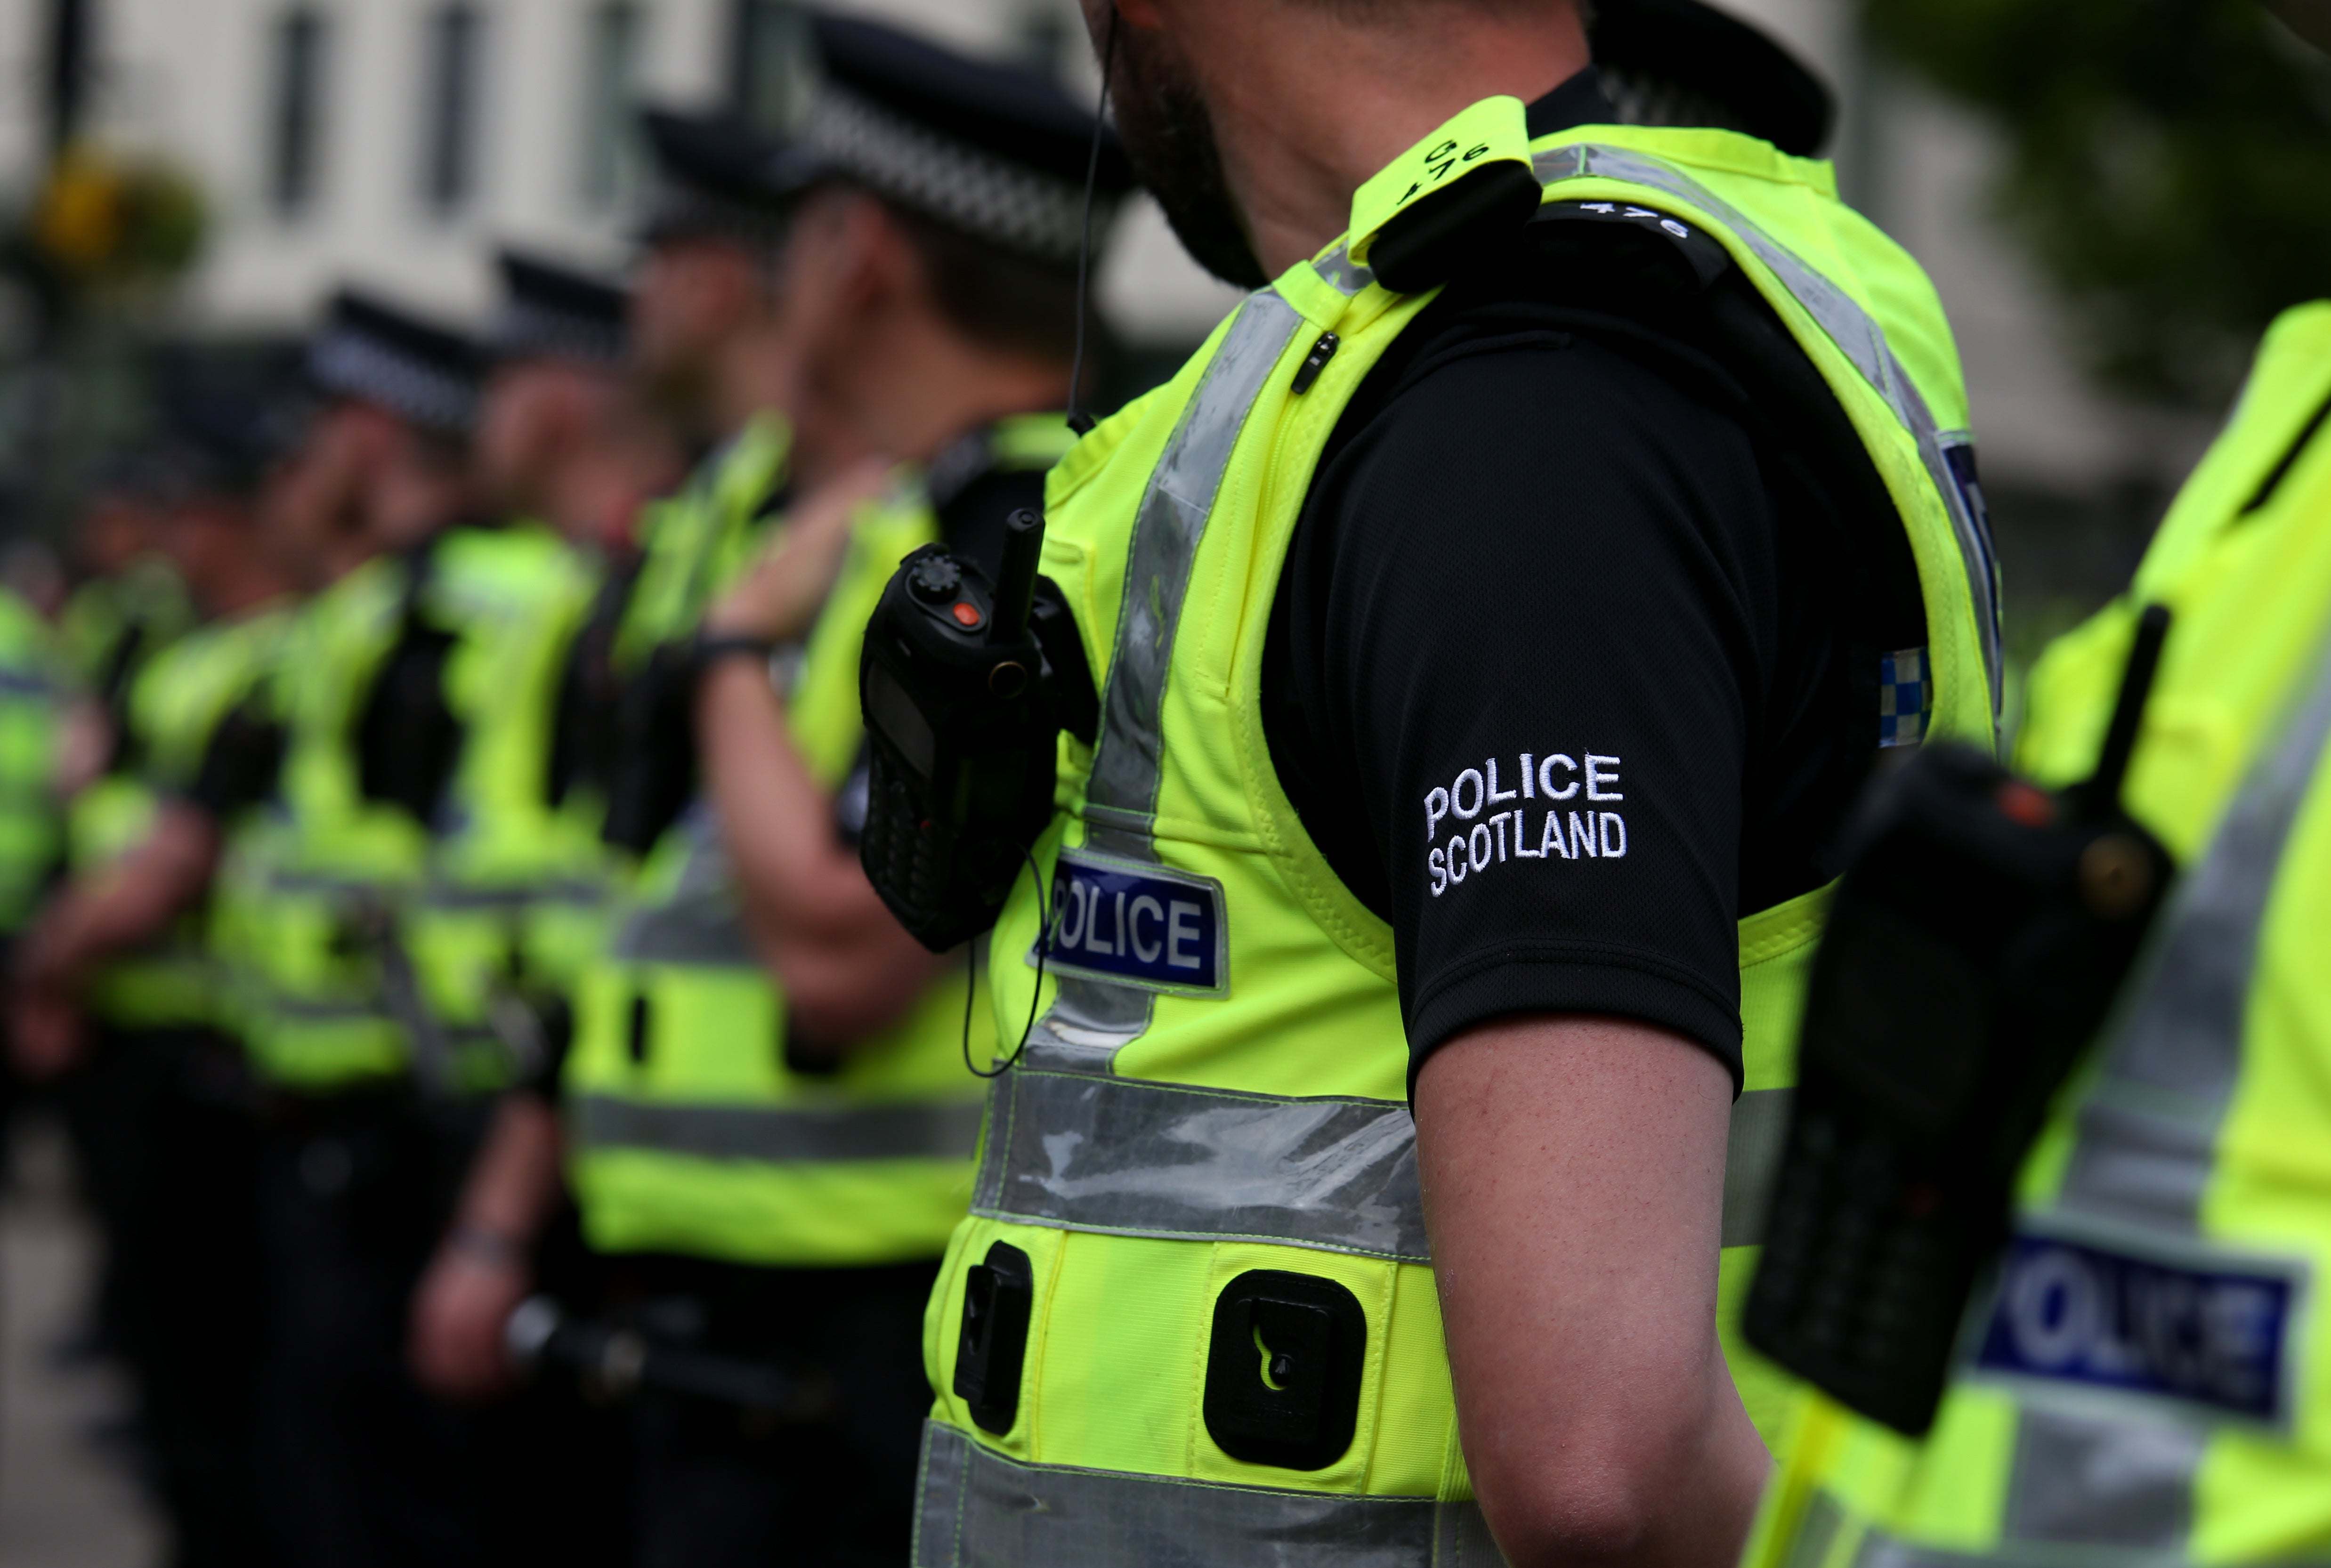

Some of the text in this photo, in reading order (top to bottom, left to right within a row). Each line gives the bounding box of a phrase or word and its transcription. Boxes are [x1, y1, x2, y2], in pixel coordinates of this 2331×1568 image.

[1396, 143, 1489, 205] 476
[1579, 203, 1689, 238] 476
[1424, 753, 1623, 842] POLICE
[1428, 808, 1627, 897] SCOTLAND
